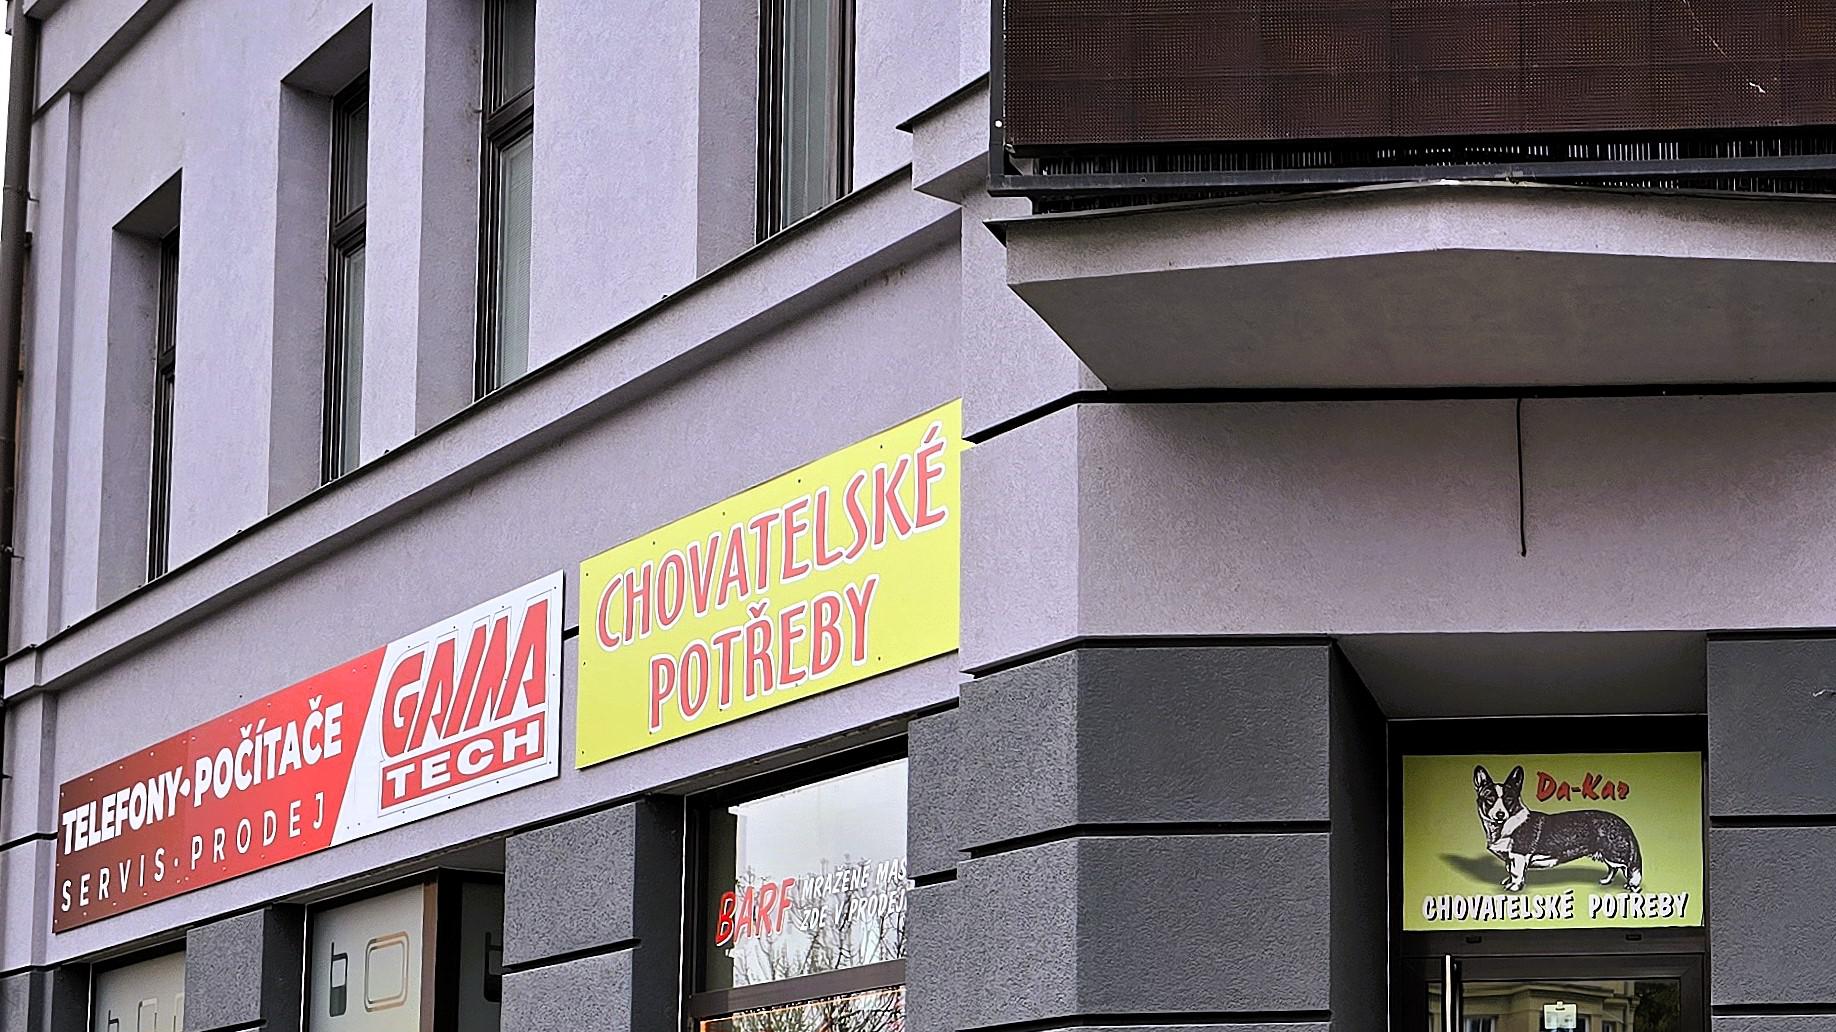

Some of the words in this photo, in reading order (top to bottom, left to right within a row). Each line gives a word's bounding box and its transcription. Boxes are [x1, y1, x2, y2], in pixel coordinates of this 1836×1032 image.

[597, 424, 947, 648] CHOVATELSKÉ
[381, 598, 549, 759] GAMA
[649, 576, 878, 730] POTŘEBY
[385, 719, 541, 801] TECH
[60, 846, 166, 913] SERVIS
[190, 791, 325, 871] PRODEJ
[801, 858, 873, 899] MRAŽENÉ
[715, 875, 798, 948] BARF
[800, 905, 827, 931] ZDE
[848, 888, 908, 922] PRODEJ
[1422, 889, 1575, 922] CHOVATELSKÉ
[1588, 886, 1690, 920] POTŘEBY
